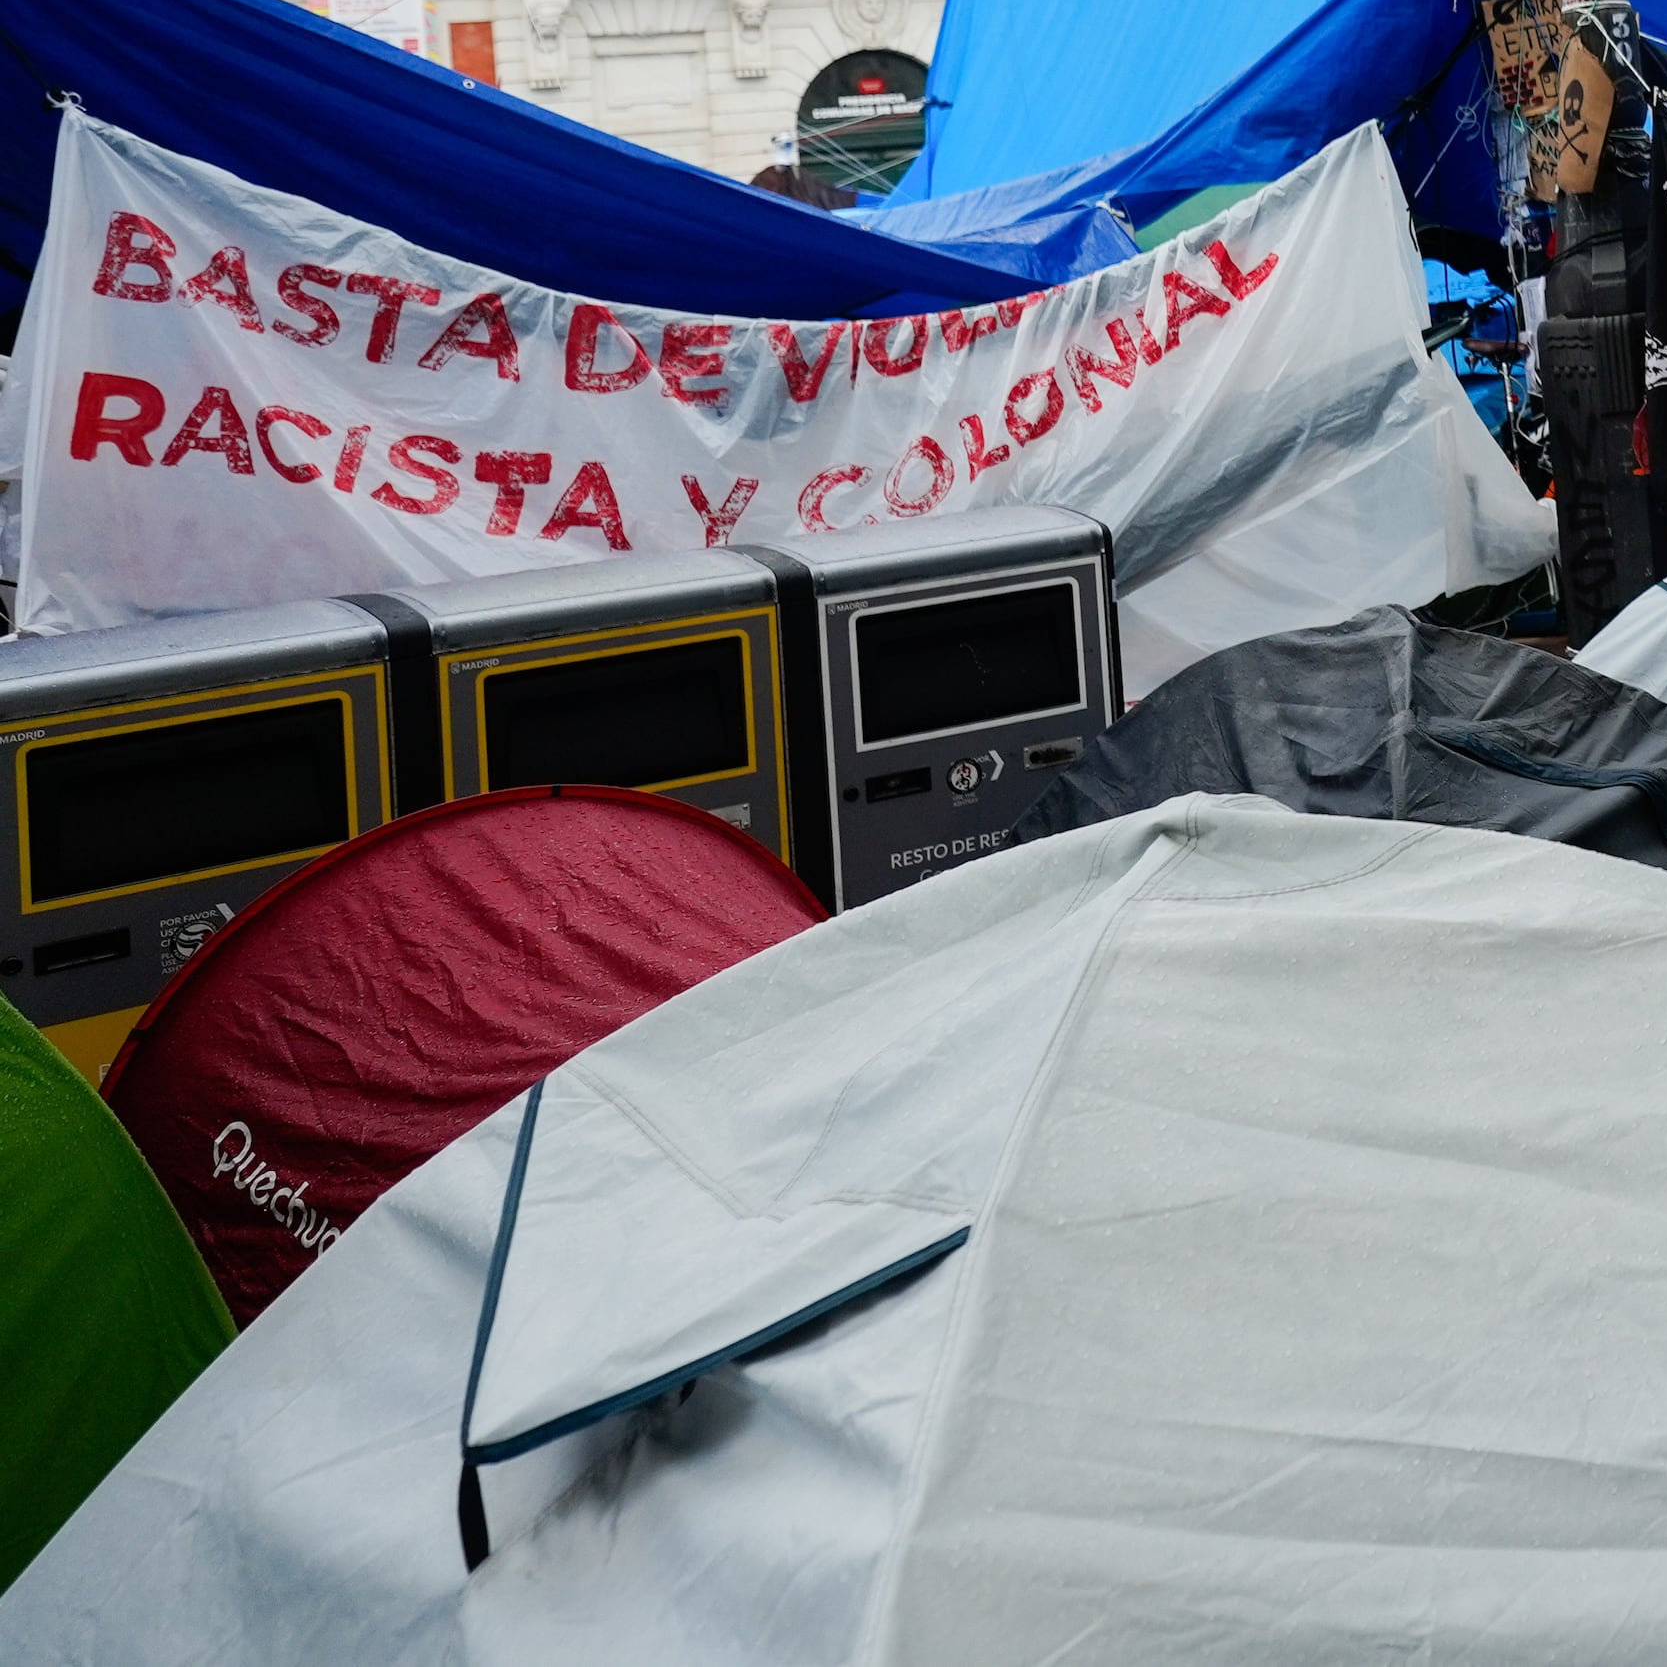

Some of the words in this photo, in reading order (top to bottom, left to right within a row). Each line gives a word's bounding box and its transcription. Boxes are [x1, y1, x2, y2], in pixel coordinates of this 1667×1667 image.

[93, 210, 520, 385] BASTA
[566, 305, 731, 408] DE
[70, 371, 633, 551] RACISTA
[681, 475, 759, 546] Y
[798, 240, 1278, 533] COLONIAL
[836, 600, 869, 613] MADRID
[462, 658, 500, 671] MADRID
[0, 729, 46, 745] MADRID
[890, 843, 948, 869] RESTO
[952, 836, 975, 856] DE
[160, 917, 181, 928] POR
